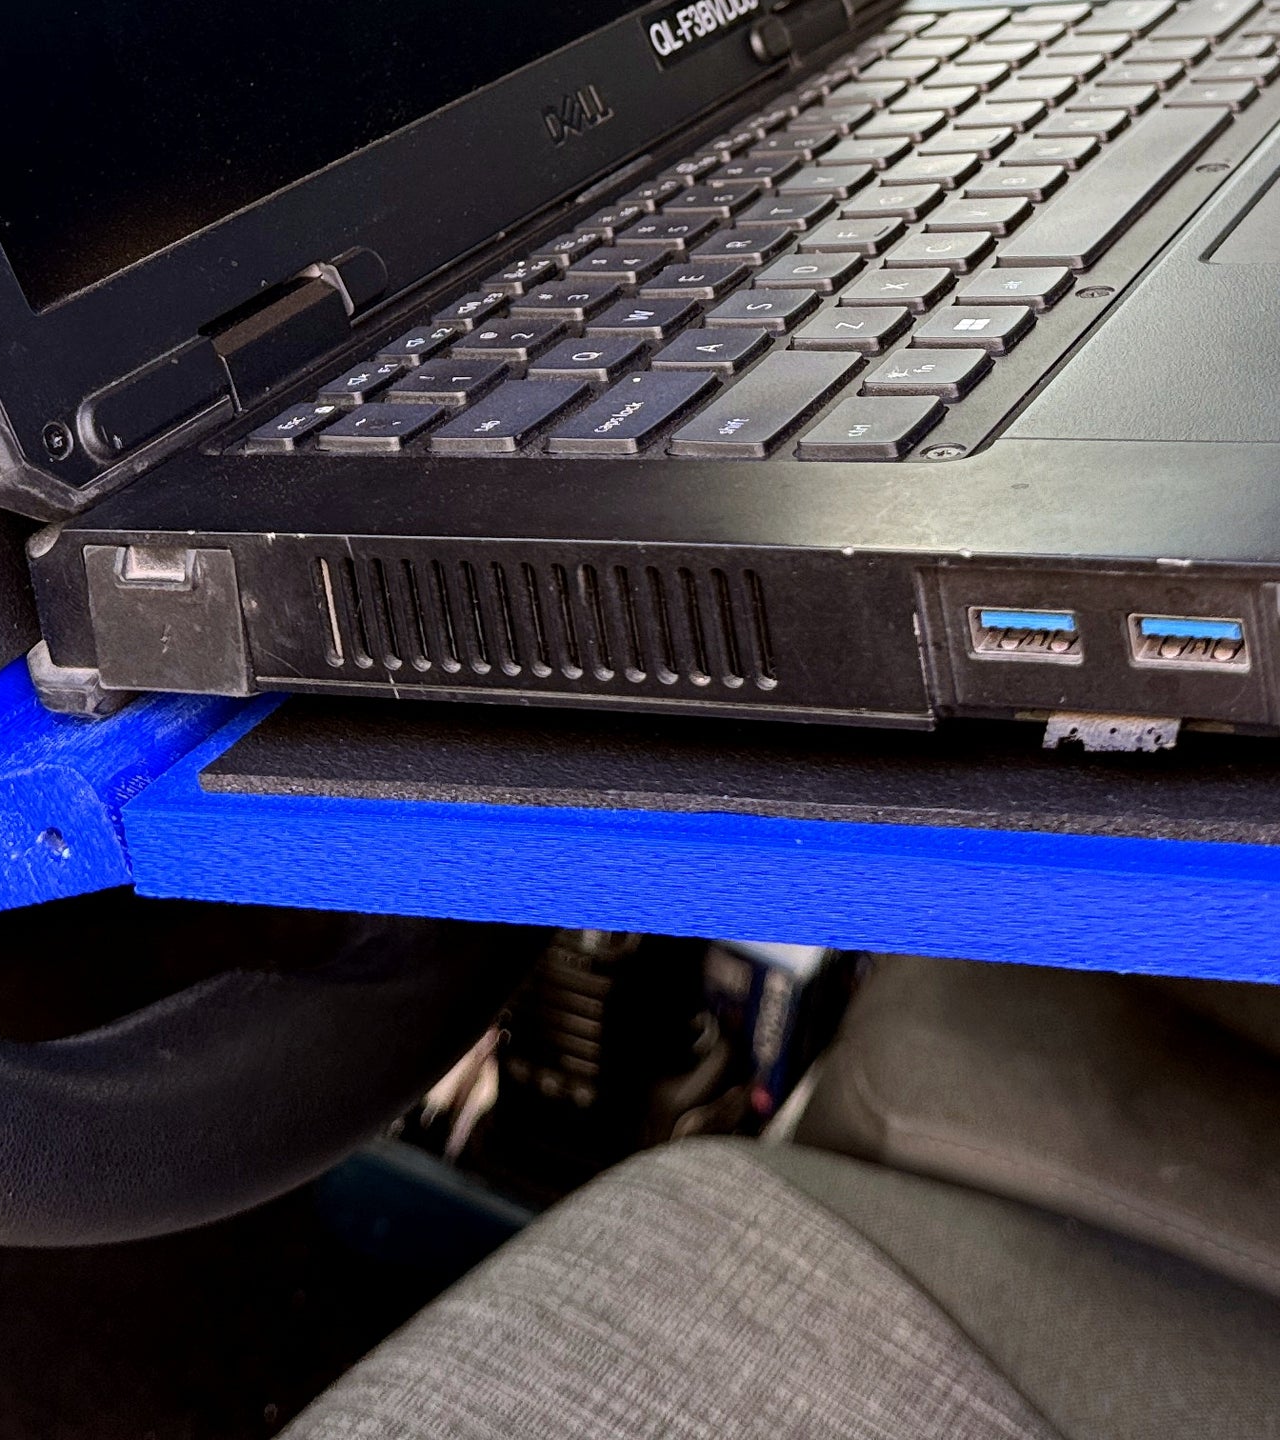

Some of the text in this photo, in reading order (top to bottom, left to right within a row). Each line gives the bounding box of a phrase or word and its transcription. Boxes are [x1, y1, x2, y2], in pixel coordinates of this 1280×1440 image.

[542, 84, 614, 147] DELL
[881, 282, 910, 291] X
[622, 310, 655, 323] W
[835, 321, 864, 330] Z
[696, 343, 724, 353] A
[572, 351, 603, 361] Q
